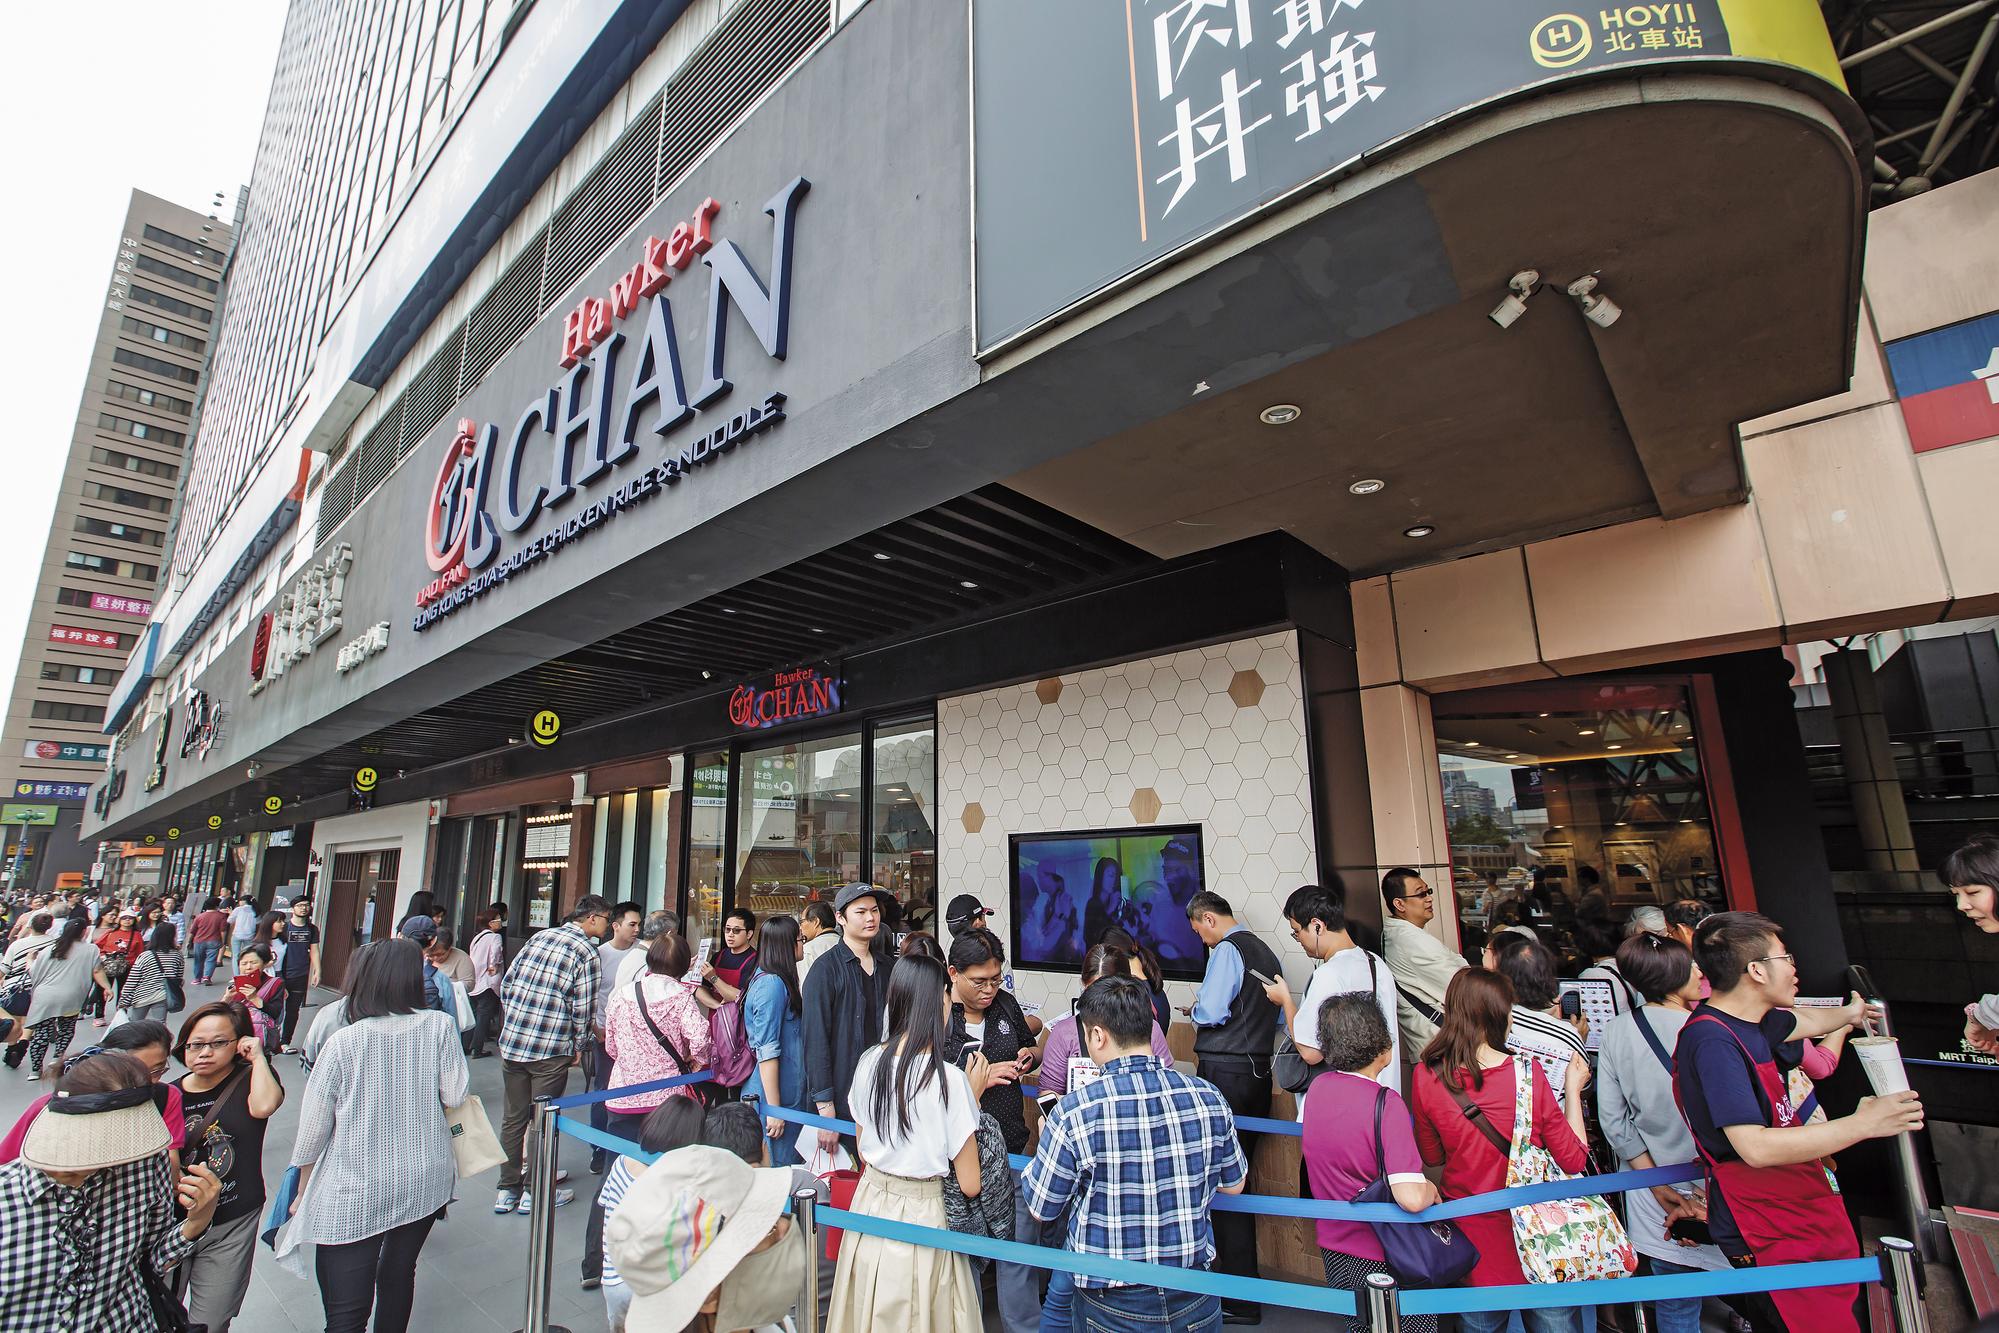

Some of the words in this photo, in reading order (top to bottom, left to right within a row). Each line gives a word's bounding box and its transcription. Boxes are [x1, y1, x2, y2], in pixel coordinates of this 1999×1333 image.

[1600, 3, 1697, 31] HOYII
[1603, 26, 1703, 54] 北車站
[559, 197, 720, 369] Hawker
[500, 176, 811, 533] CHAN
[412, 603, 440, 632] HONG
[438, 586, 469, 617] KONG
[467, 567, 499, 599] SOYA
[498, 539, 546, 580] SAUCE
[542, 497, 614, 553] CHICKEN
[613, 467, 660, 511] RICE
[656, 458, 679, 485] &
[677, 392, 787, 473] NOODLE
[416, 577, 443, 608] LIAO
[441, 560, 470, 591] FAN
[51, 629, 117, 645] 福邦證券
[775, 667, 814, 687] Hawker
[759, 677, 832, 722] CHAN
[1939, 1051, 1967, 1062] MRT
